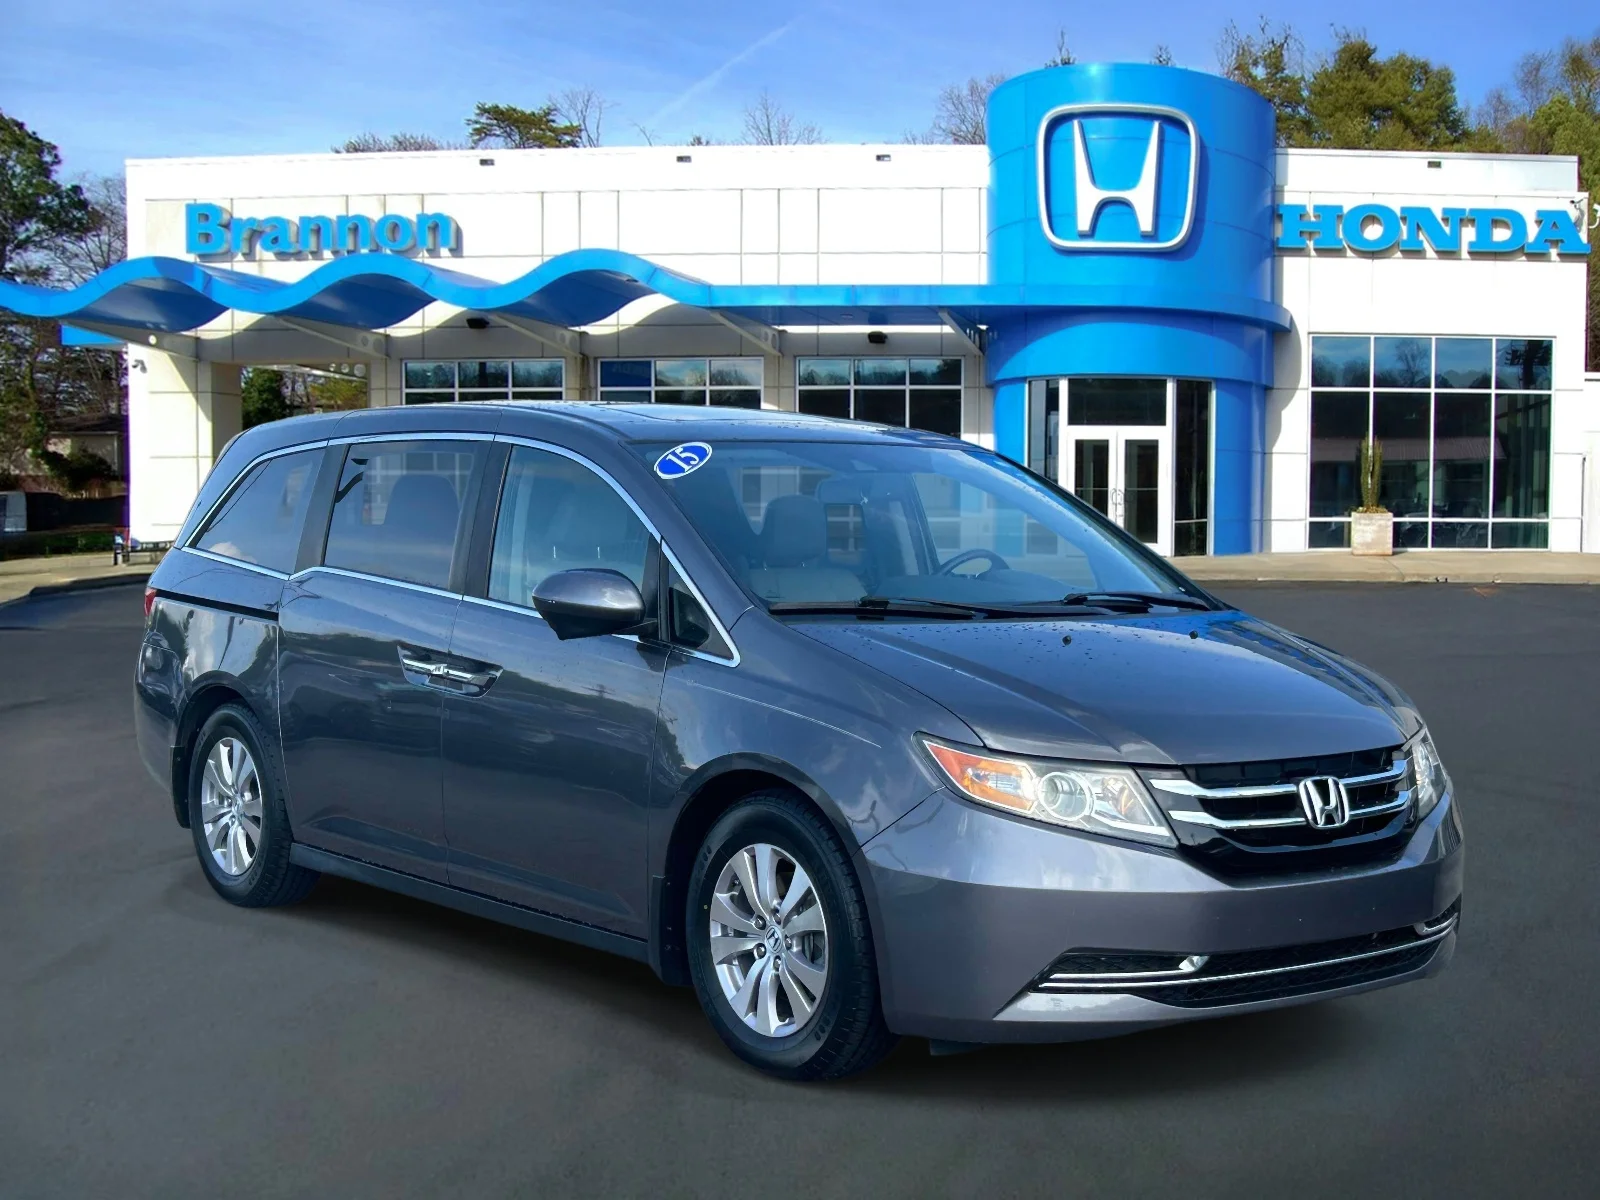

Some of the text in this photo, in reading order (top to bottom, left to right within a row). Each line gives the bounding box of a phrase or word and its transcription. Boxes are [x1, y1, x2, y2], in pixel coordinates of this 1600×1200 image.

[185, 203, 454, 255] Brannon
[1276, 204, 1592, 254] HONDA
[666, 447, 700, 473] 15
